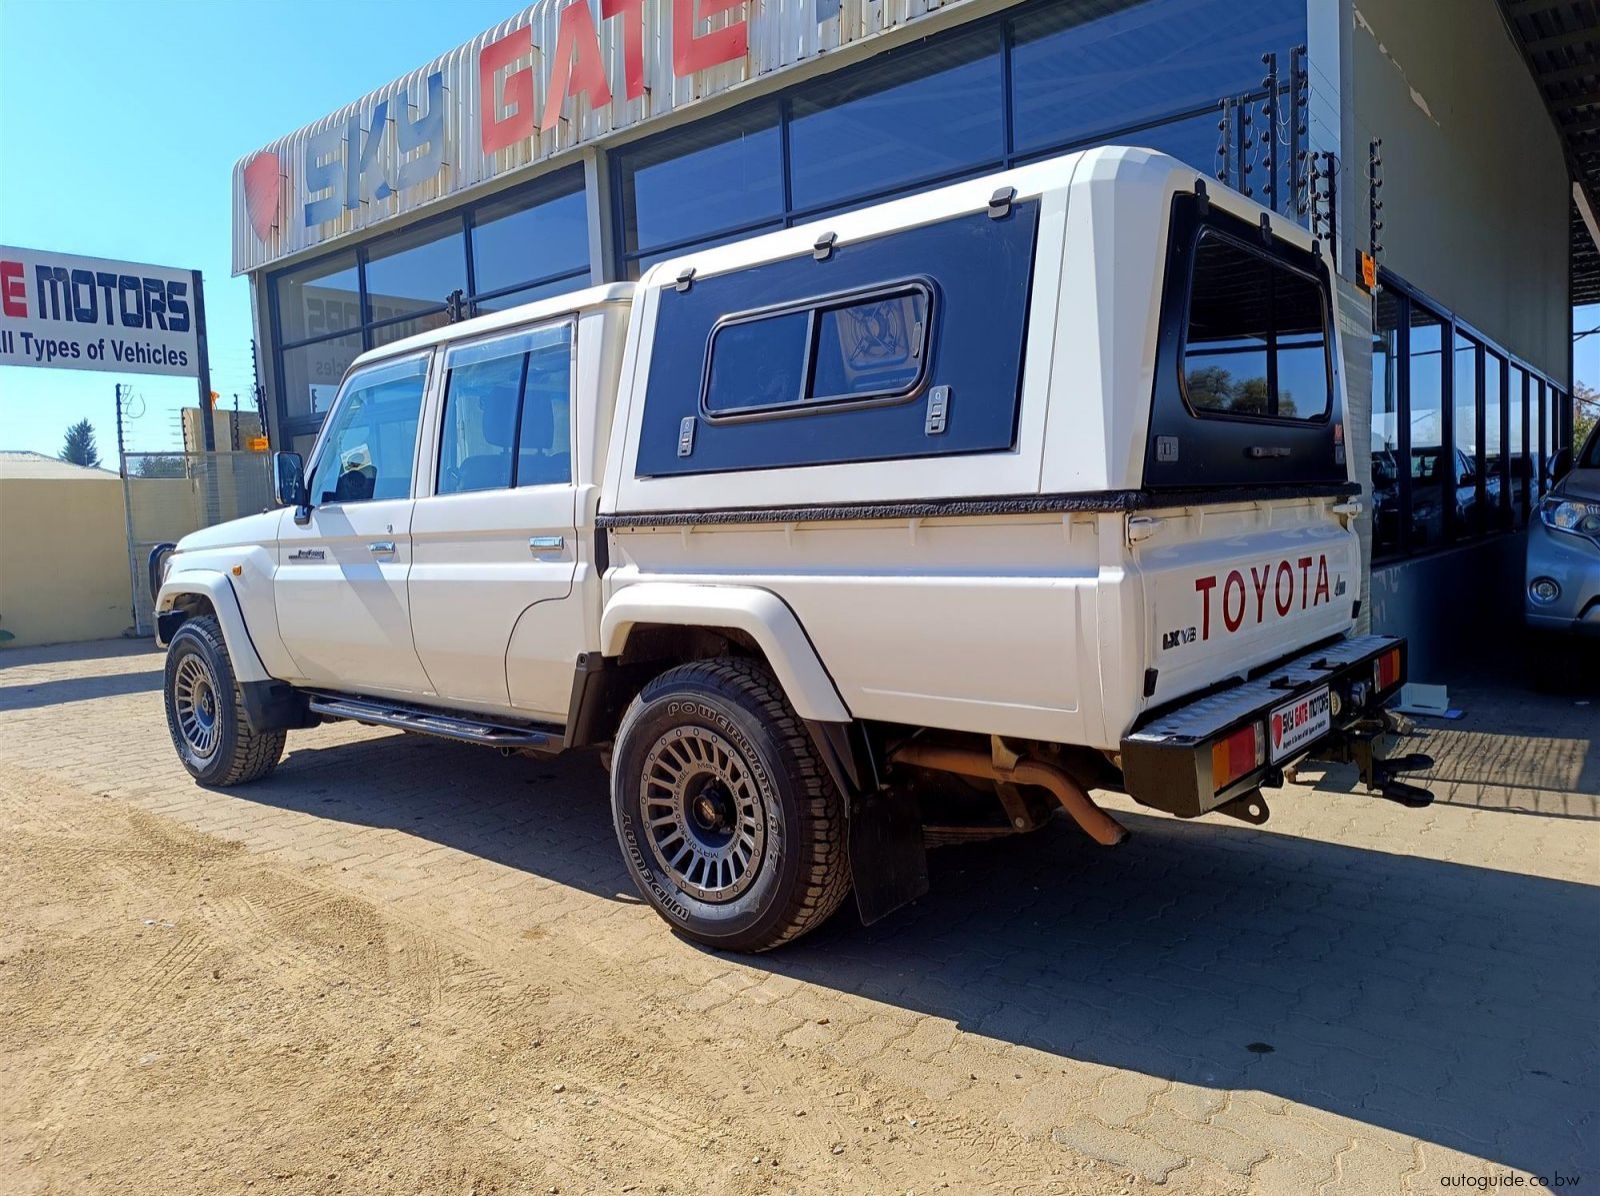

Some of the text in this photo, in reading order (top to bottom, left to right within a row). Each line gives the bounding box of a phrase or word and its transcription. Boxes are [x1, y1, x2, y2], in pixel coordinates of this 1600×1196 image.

[304, 0, 748, 228] SKY GATE
[35, 264, 190, 333] MOTORS
[0, 330, 188, 366] ll Types of Vehicles
[1195, 555, 1330, 641] TOYOTA
